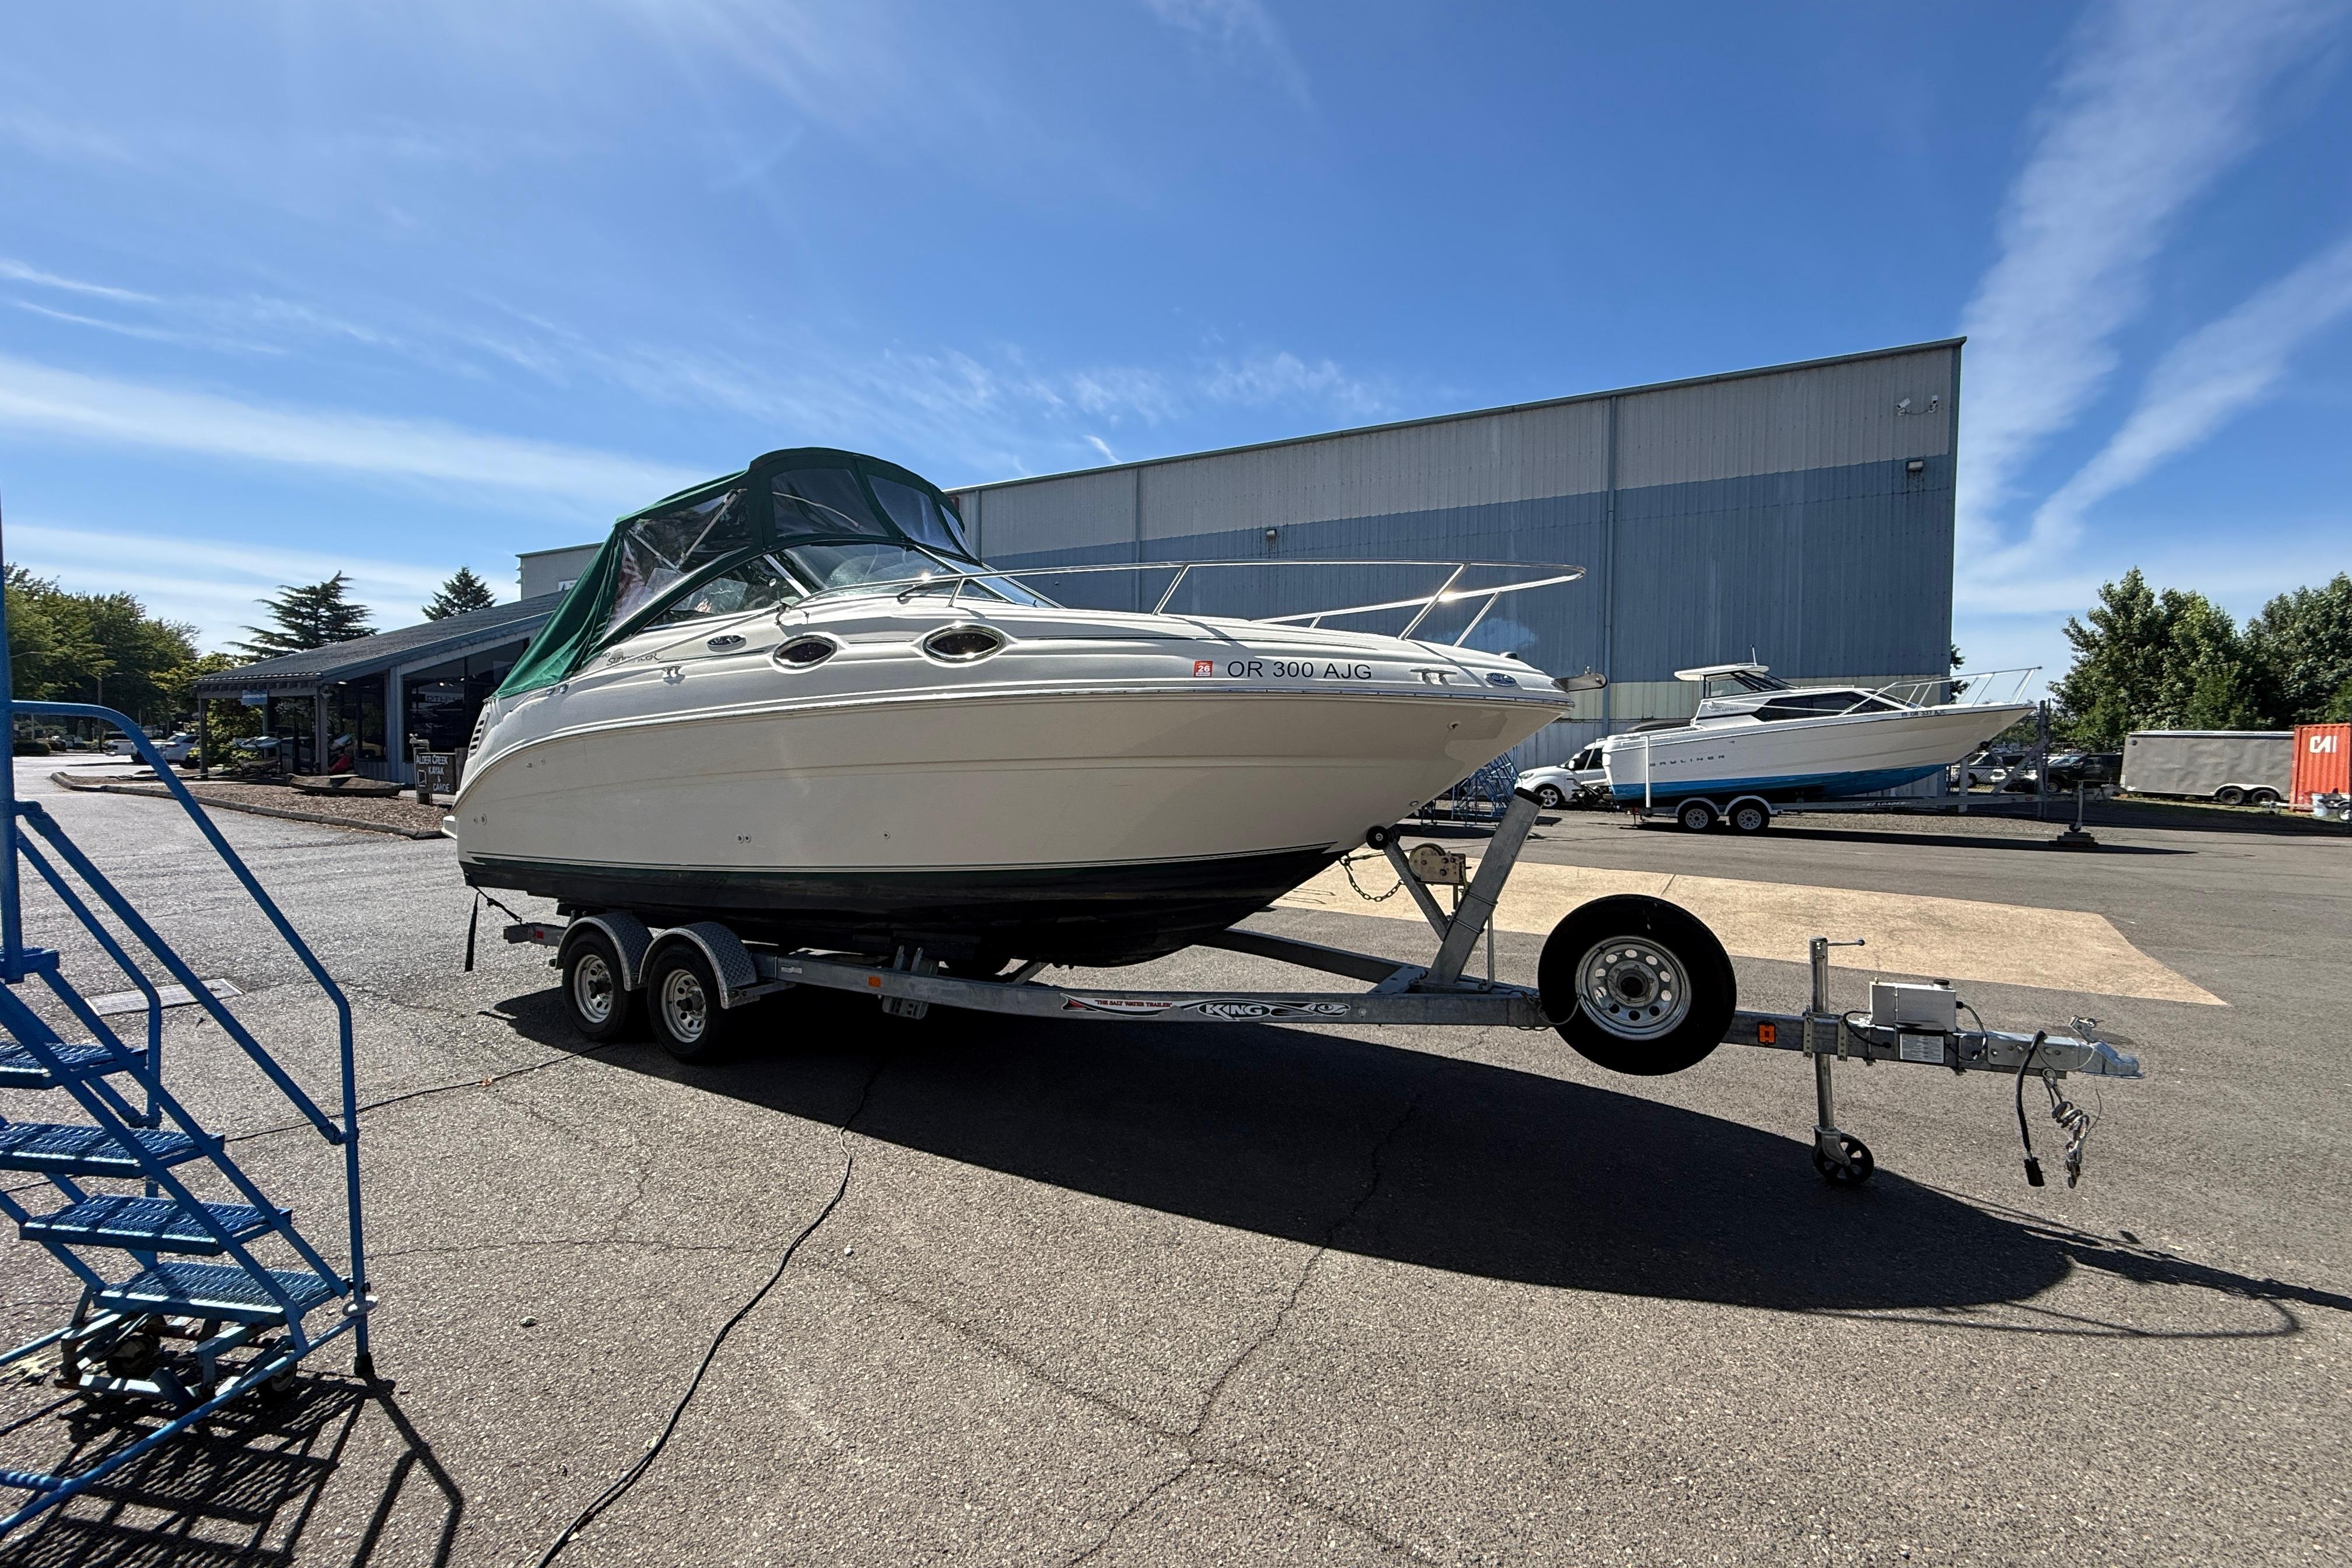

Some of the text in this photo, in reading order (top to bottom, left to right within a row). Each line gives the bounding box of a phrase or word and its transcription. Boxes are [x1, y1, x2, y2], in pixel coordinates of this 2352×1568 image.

[1227, 661, 1371, 680] OR 300 AJG
[2309, 735, 2337, 753] CAI
[416, 754, 448, 765] ALDER CREEK
[1649, 755, 1725, 766] BAYLINER
[428, 766, 444, 775] KAYAK
[433, 783, 450, 792] CANOE
[1205, 1004, 1263, 1020] KING
